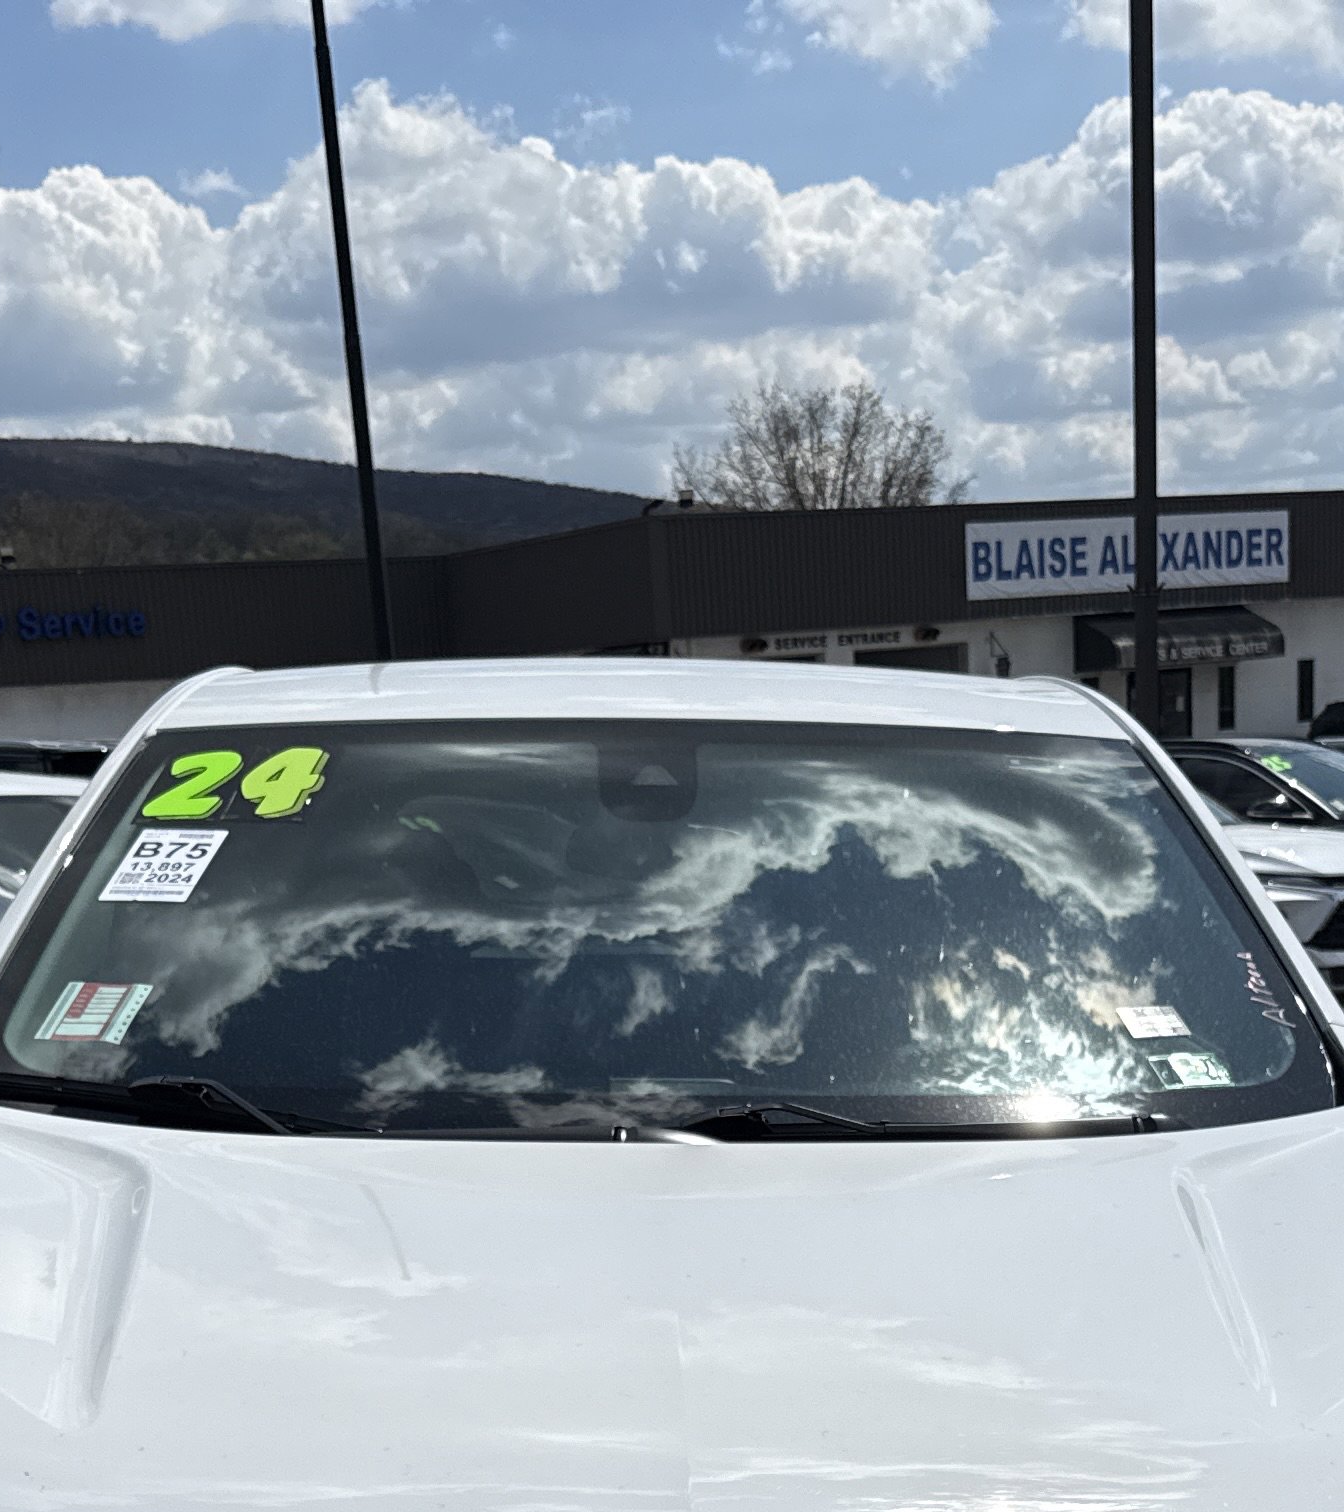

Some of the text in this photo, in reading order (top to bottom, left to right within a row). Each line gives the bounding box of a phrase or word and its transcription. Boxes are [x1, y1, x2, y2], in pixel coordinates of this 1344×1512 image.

[971, 527, 1285, 583] BLAISE ALXANDER
[17, 602, 147, 641] Service
[773, 629, 901, 650] SERVICE ENTRANCE
[141, 746, 331, 821] 24
[131, 841, 213, 860] B75
[130, 861, 196, 875] 13,897
[143, 873, 194, 884] 2024
